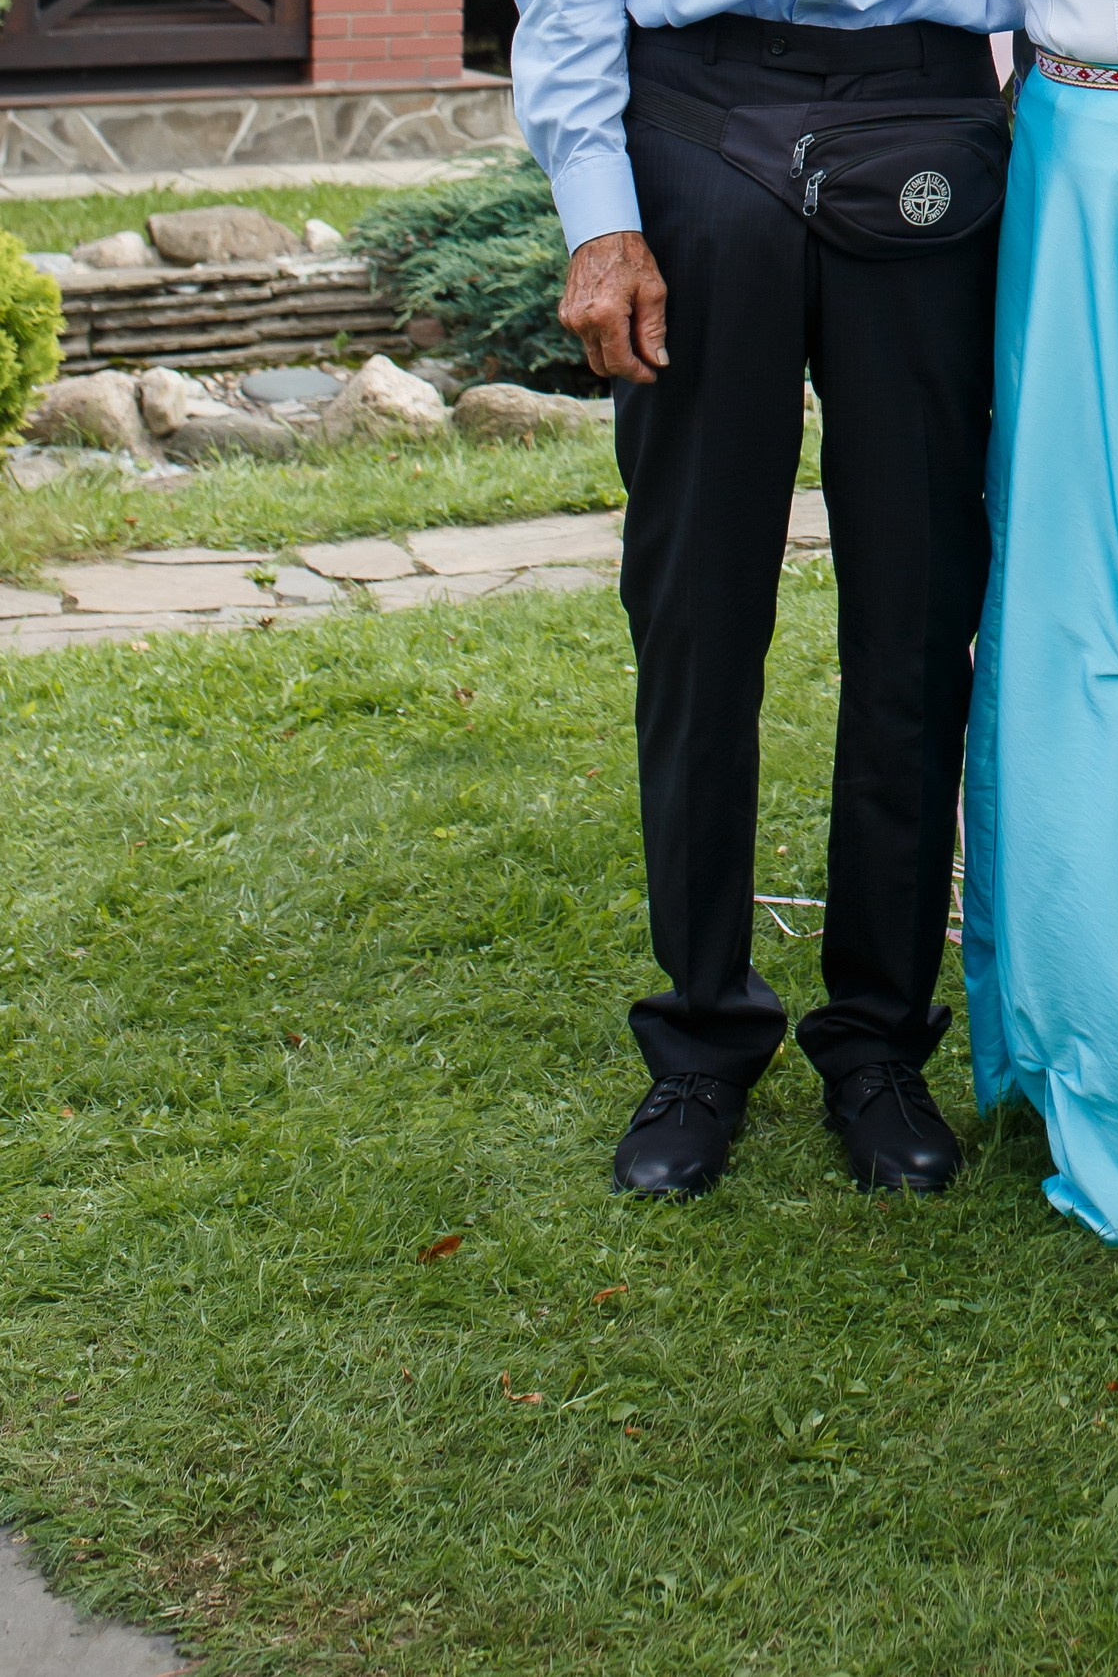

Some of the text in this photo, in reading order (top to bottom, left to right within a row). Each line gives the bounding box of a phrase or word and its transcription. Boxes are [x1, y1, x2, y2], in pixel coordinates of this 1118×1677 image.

[904, 175, 948, 196] STONE ISLAND
[903, 200, 946, 222] STONE ISLAND
